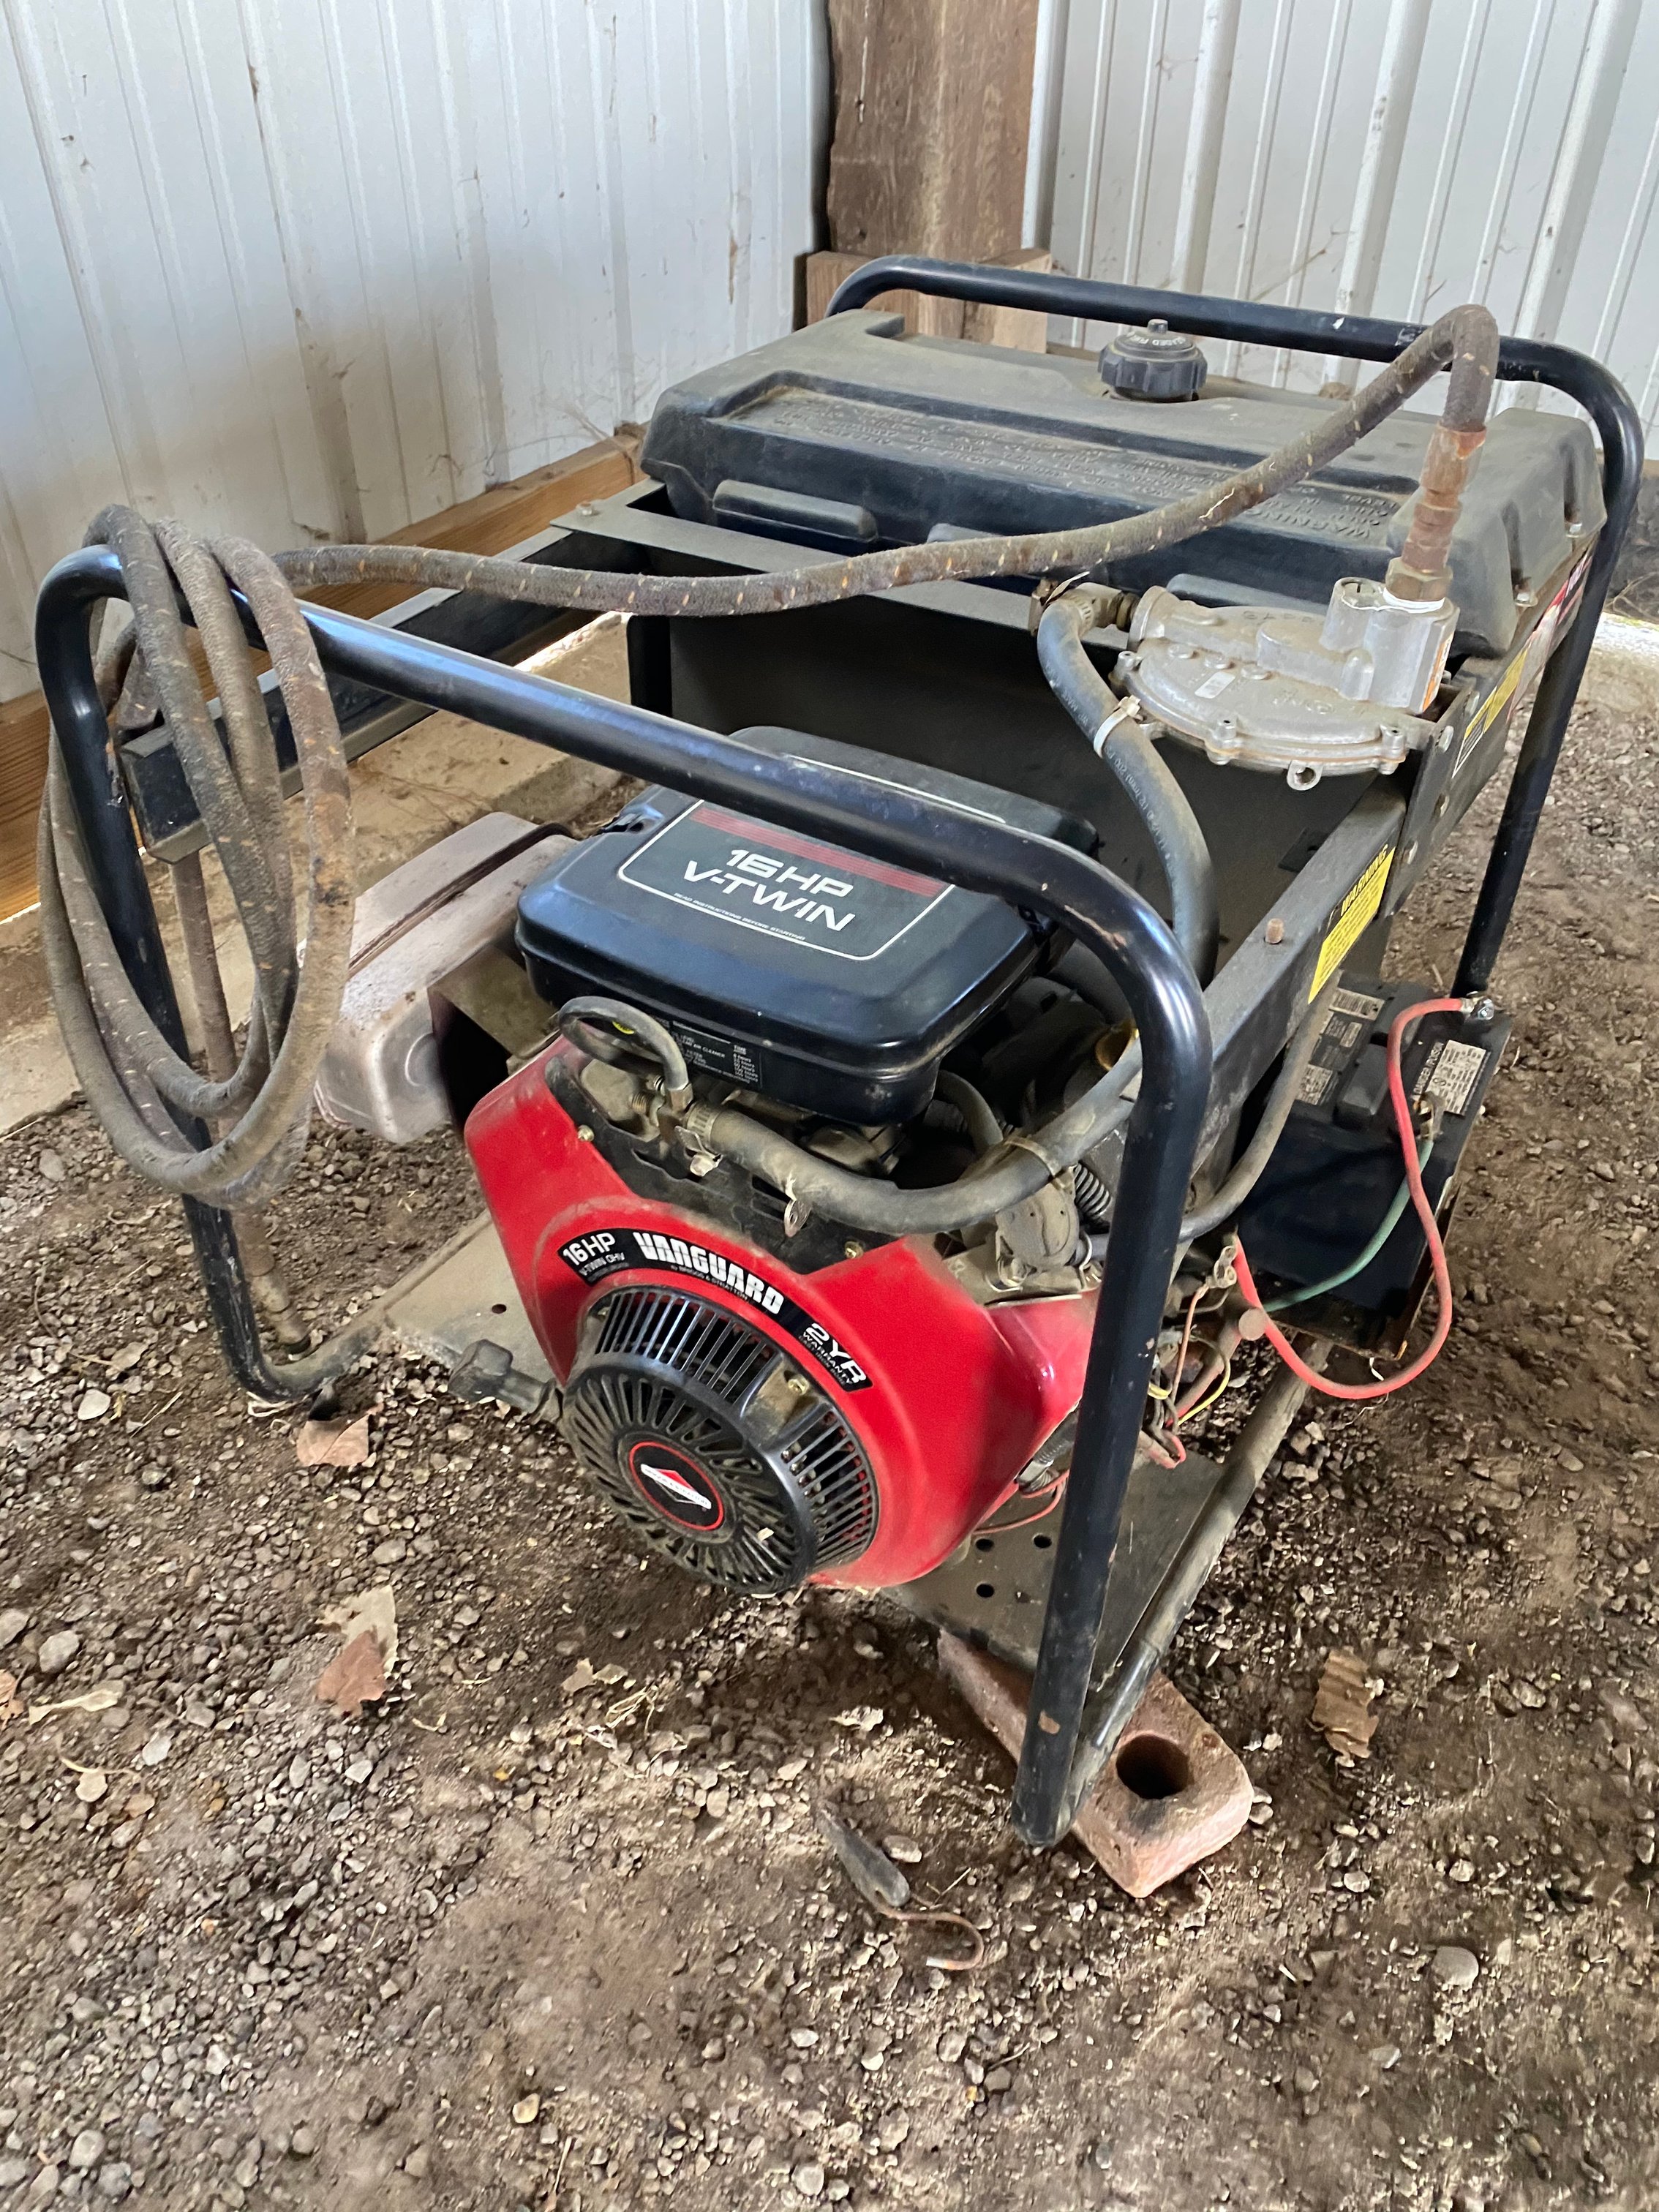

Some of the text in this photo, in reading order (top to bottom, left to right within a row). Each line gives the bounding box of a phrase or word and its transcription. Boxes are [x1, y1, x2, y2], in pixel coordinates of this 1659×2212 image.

[682, 859, 857, 932] V-TWIN
[726, 849, 854, 898] 16HP
[563, 1232, 616, 1265] 16HP
[633, 1231, 785, 1315] VANGUARD
[802, 1331, 853, 1384] WARRANTY
